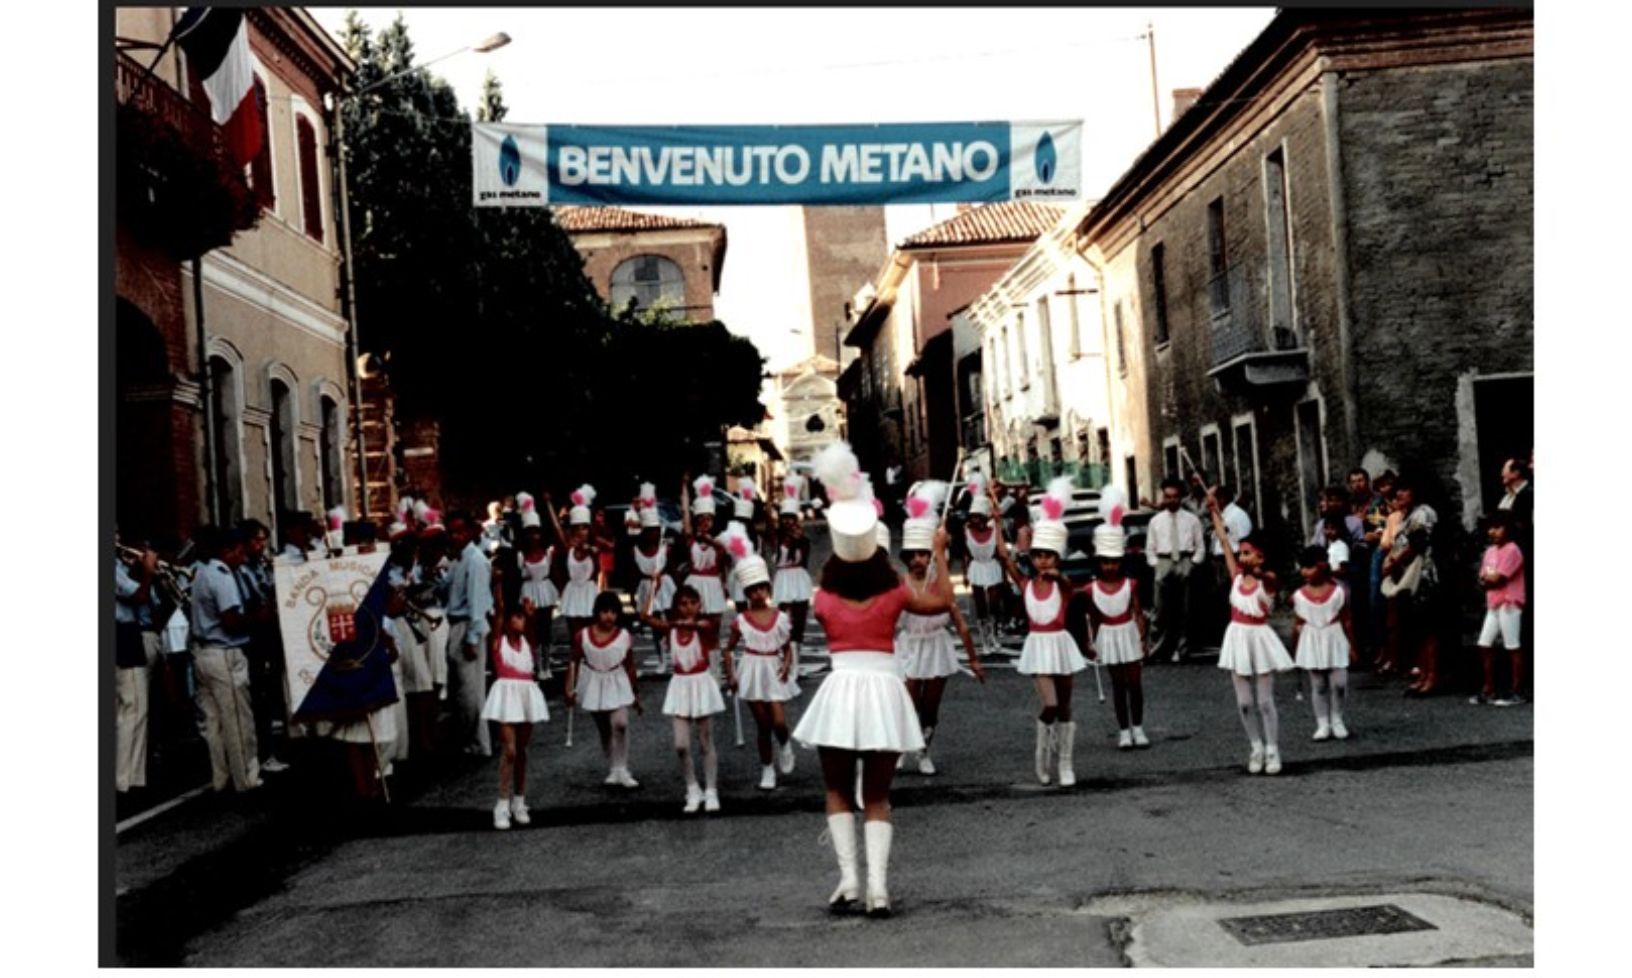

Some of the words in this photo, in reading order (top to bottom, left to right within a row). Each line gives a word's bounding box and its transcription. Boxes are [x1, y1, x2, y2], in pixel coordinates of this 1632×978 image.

[559, 145, 809, 186] BENVENUTO
[820, 141, 998, 183] METANO
[479, 192, 497, 201] gas
[499, 191, 541, 199] metano
[1015, 188, 1032, 197] gas
[1034, 188, 1077, 197] metano
[285, 570, 319, 608] BANDA
